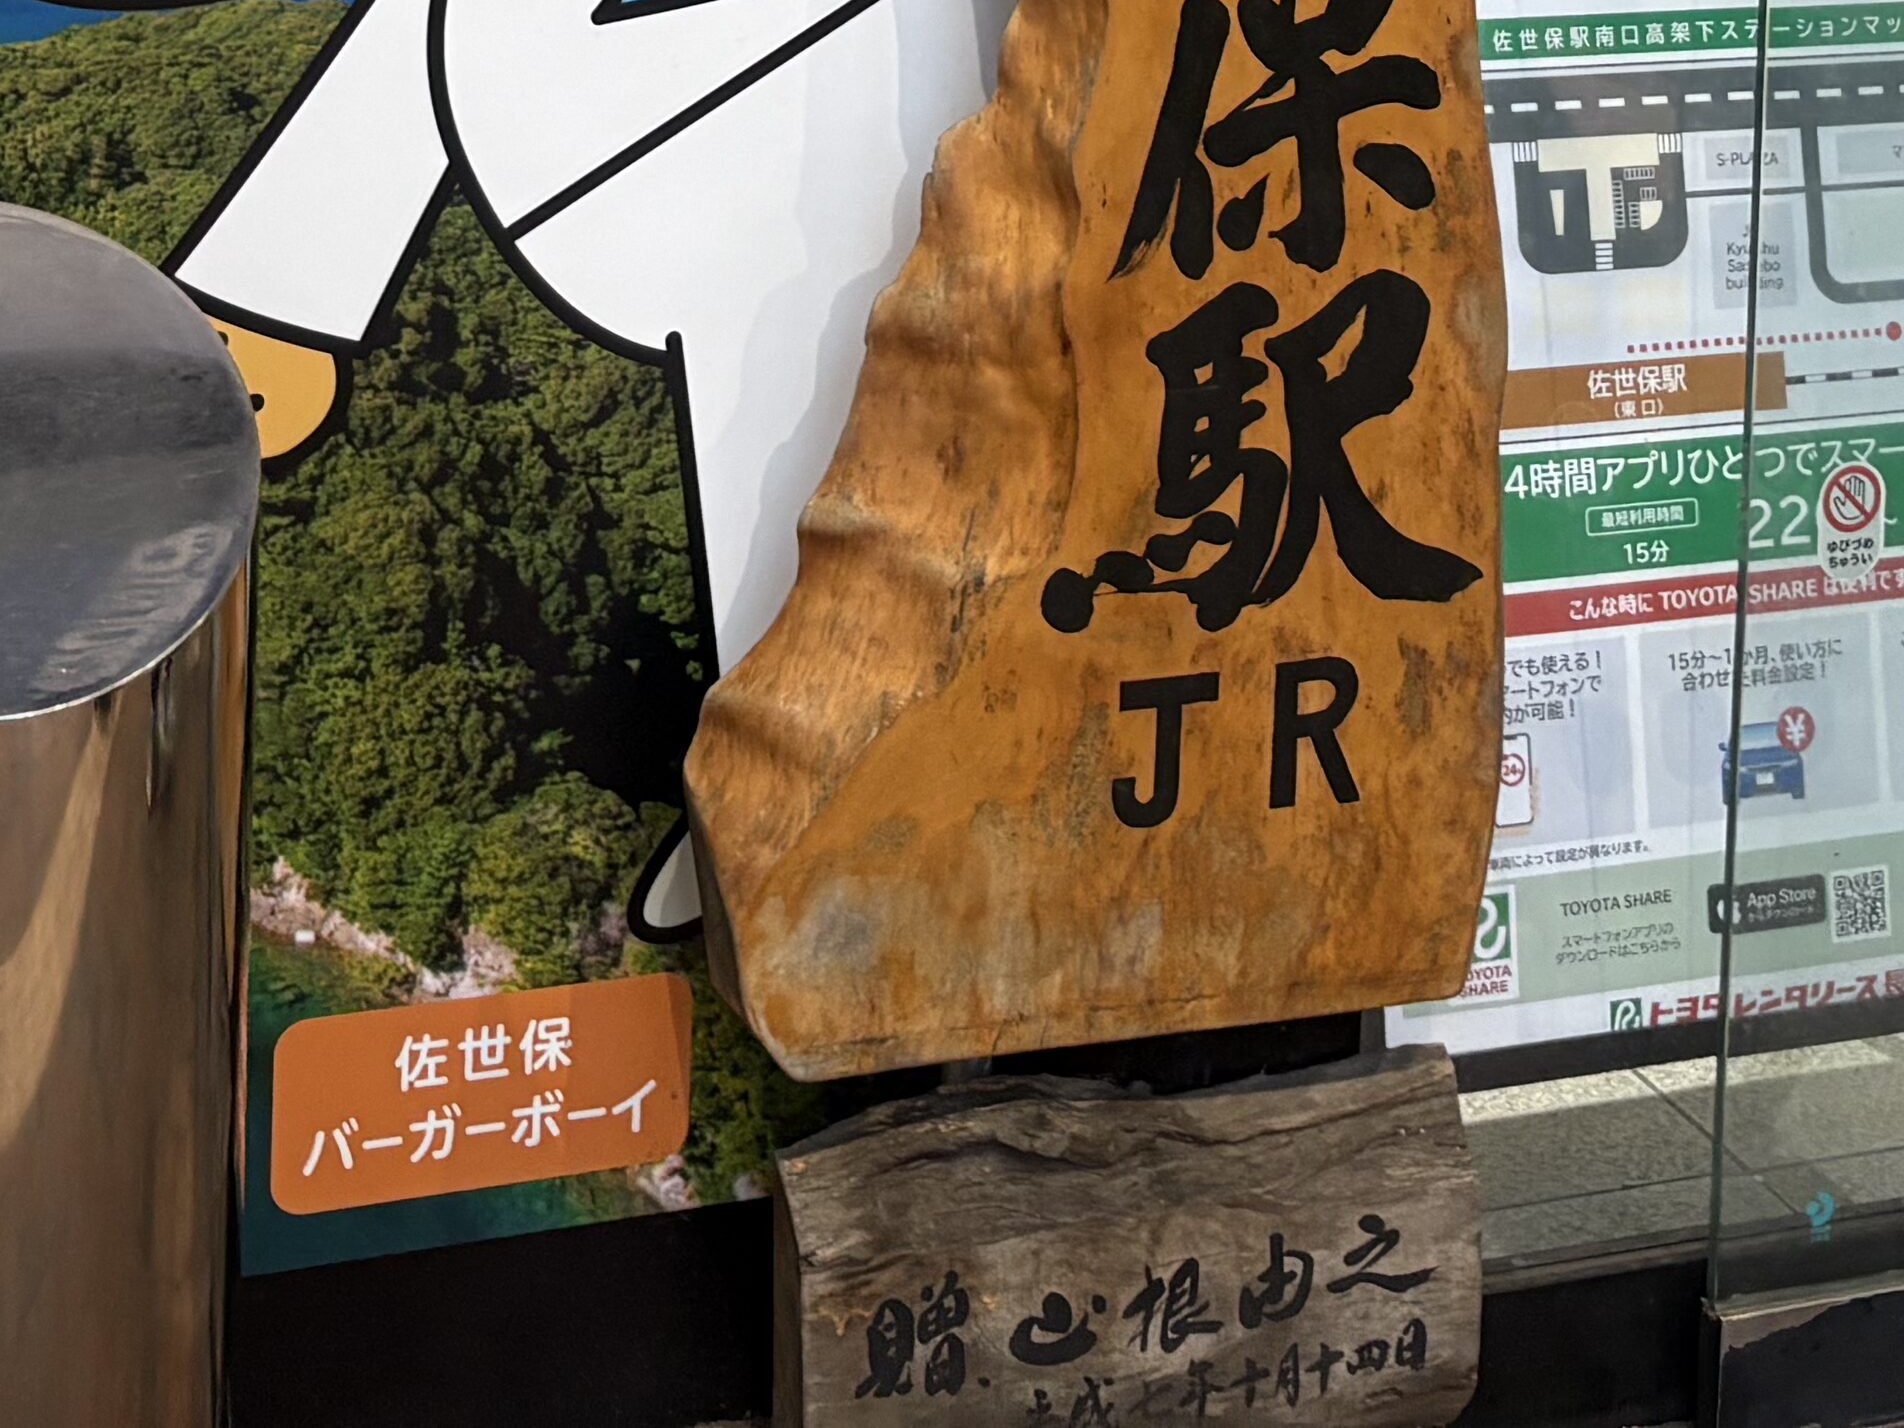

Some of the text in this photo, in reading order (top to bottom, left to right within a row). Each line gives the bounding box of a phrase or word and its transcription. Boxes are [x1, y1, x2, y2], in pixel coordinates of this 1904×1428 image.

[1587, 363, 1689, 400] 佐世保駅
[1623, 539, 1670, 565] 15分
[1568, 592, 1654, 621] こんな時に
[1660, 585, 1738, 611] TOYOTA
[1749, 578, 1819, 605] SHARE
[1504, 649, 1602, 679] でも使える!
[1110, 653, 1364, 831] JR
[1559, 888, 1673, 918] TOYOTA SHARE
[1747, 888, 1817, 909] App Store
[394, 1013, 574, 1091] 佐世保
[301, 1076, 660, 1179] バーガーボーイ
